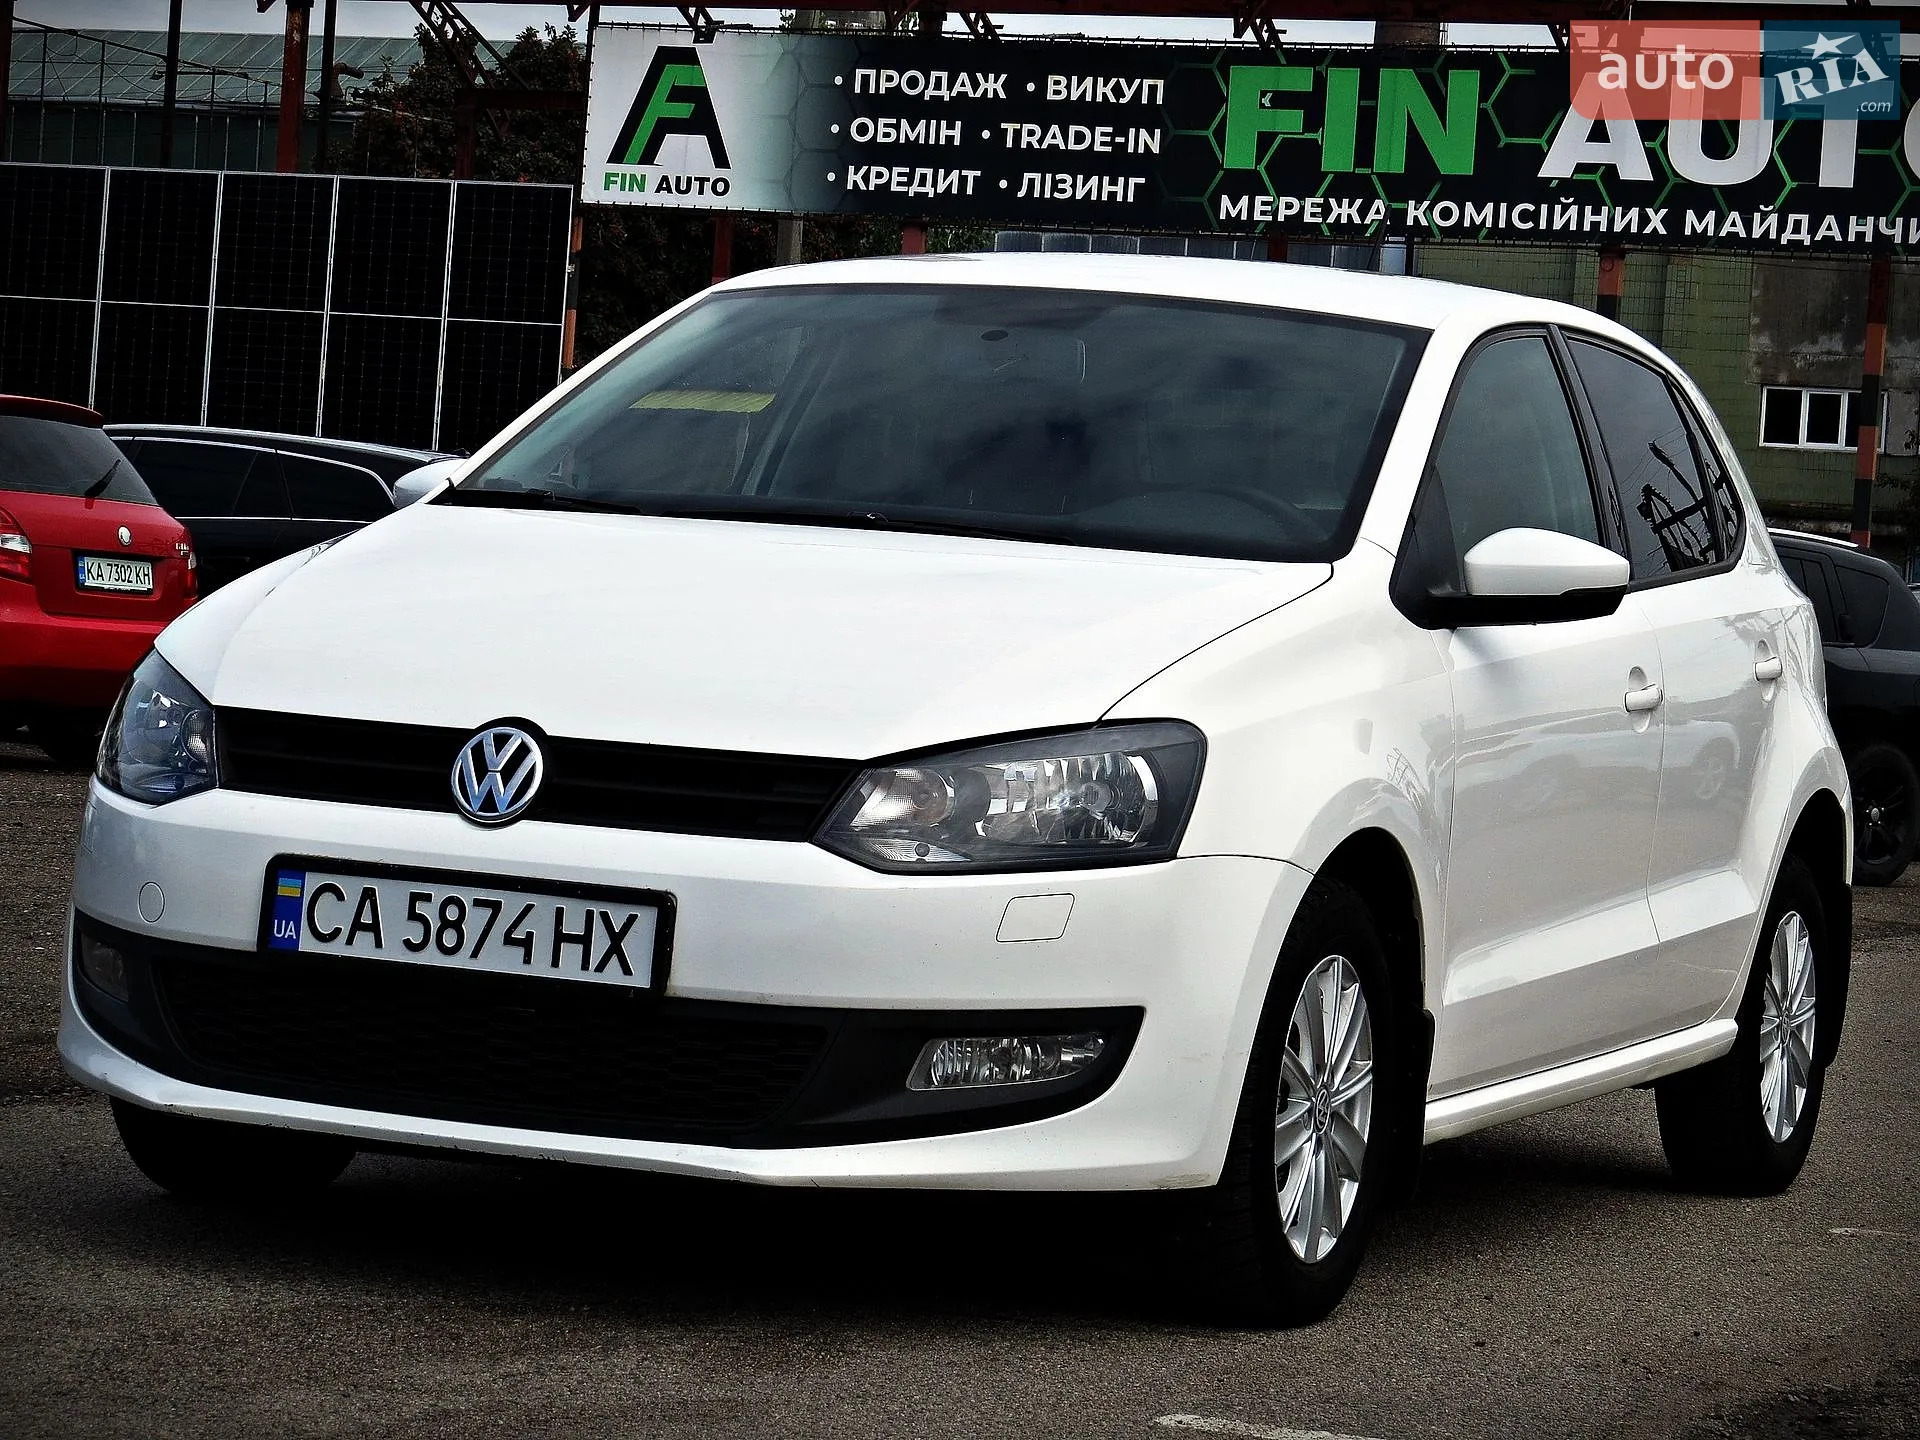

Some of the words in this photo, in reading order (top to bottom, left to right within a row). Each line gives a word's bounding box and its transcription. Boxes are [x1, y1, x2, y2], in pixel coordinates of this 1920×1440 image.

[853, 68, 1007, 100] ПРОДАЖ
[1046, 75, 1165, 105] ВИКУП
[849, 117, 962, 146] ОБМІН
[1001, 123, 1161, 154] TRADE-IN
[1223, 65, 1480, 175] FIN
[1537, 70, 1920, 188] AUT
[603, 172, 646, 192] FIN
[654, 175, 731, 197] AUTO
[846, 166, 982, 197] КРЕДИТ
[1017, 172, 1146, 203] ЛІЗИНГ
[1219, 194, 1389, 225] МЕРЕЖА
[1407, 197, 1668, 236] КОМІСІЙНИХ
[86, 561, 105, 581] KA
[106, 563, 133, 583] 7302
[134, 566, 151, 585] KH
[273, 920, 296, 939] UA
[306, 882, 384, 948] CA
[402, 890, 536, 965] 5874
[551, 906, 639, 976] HX
